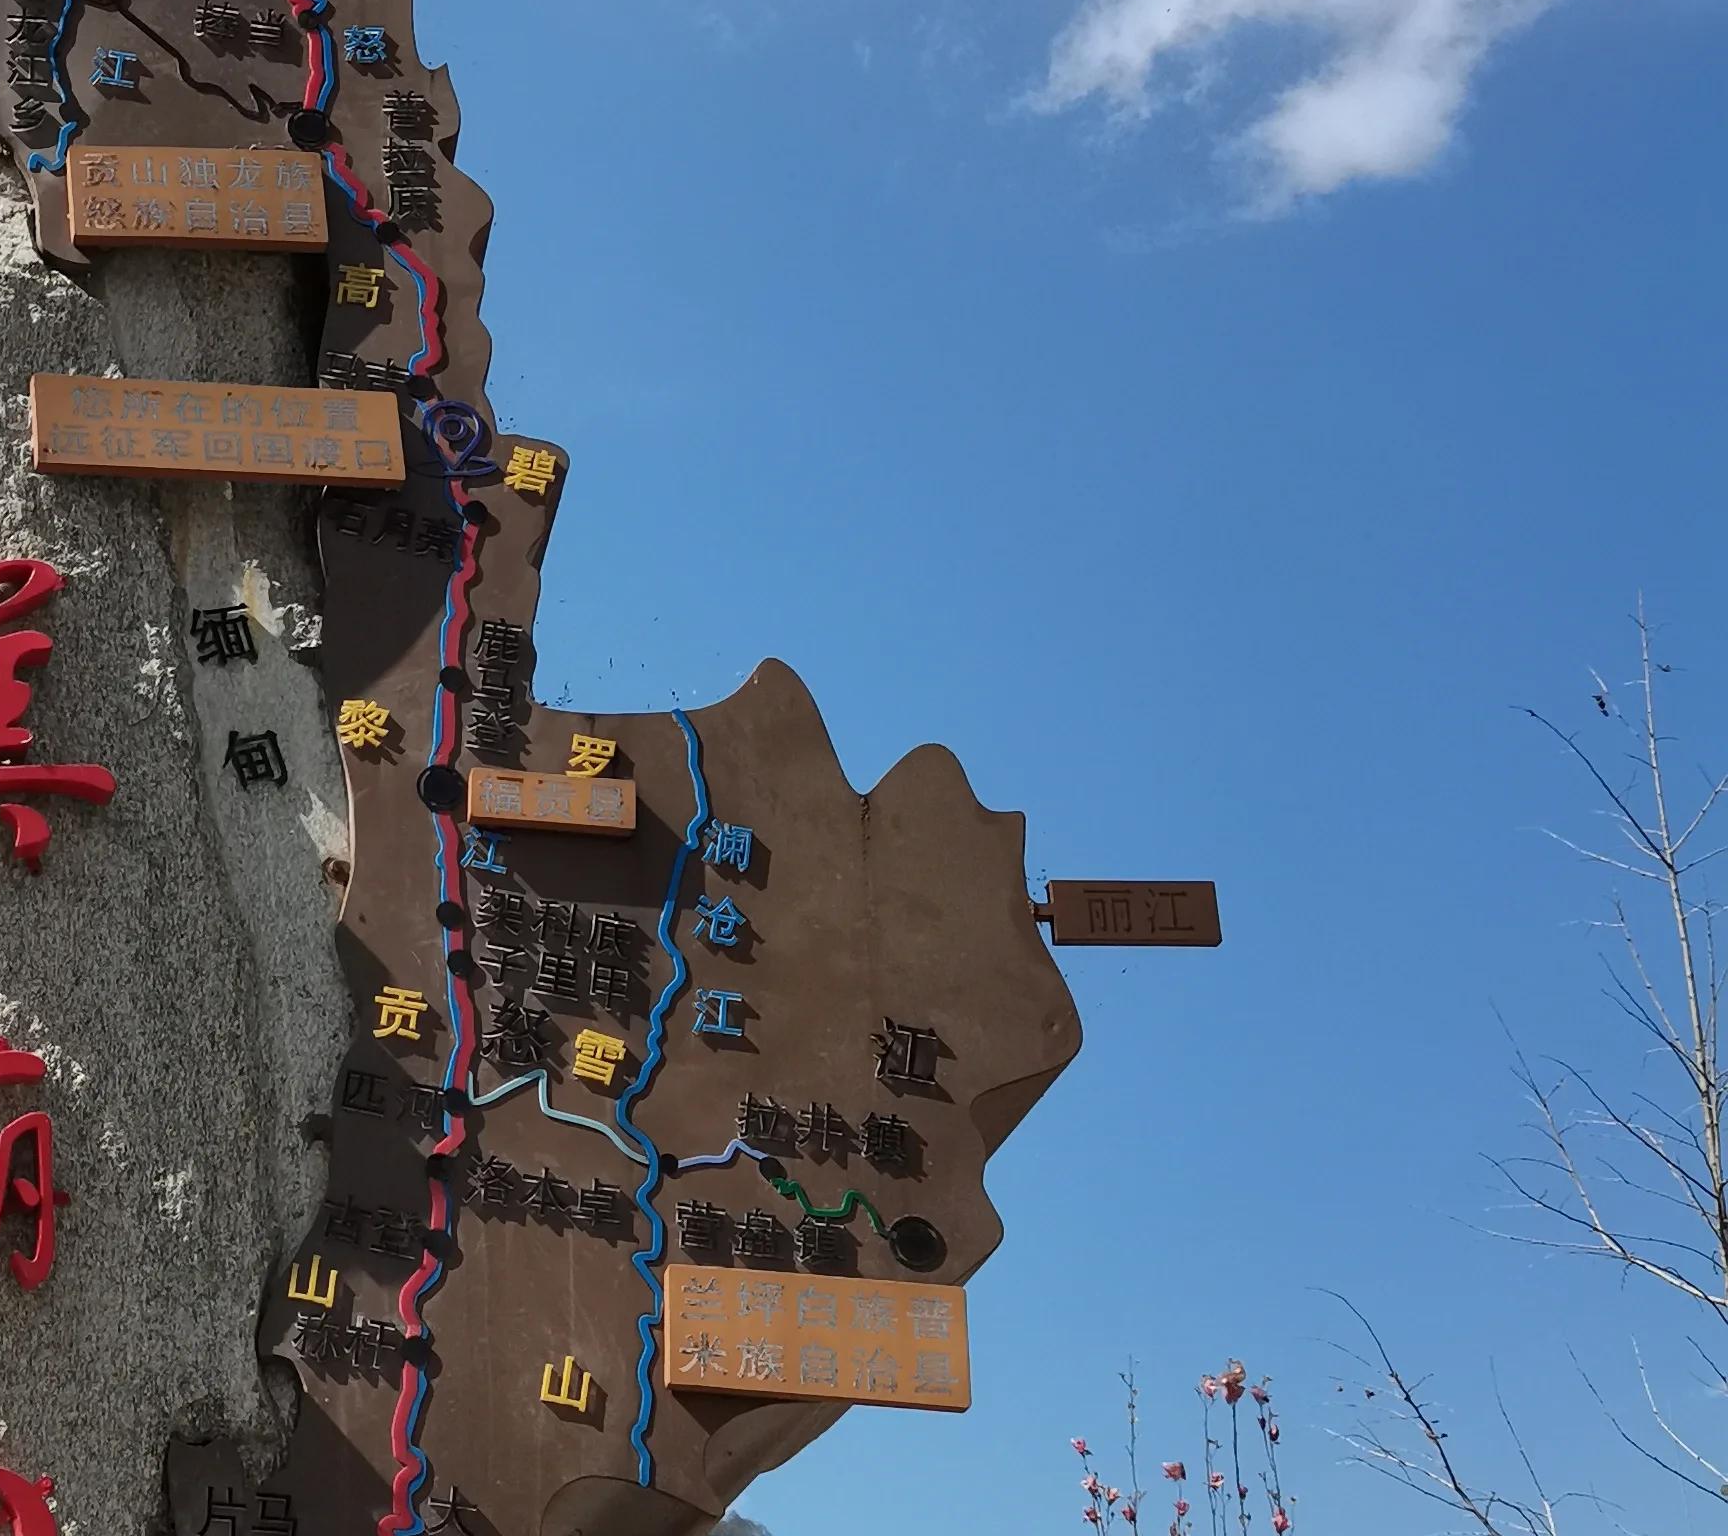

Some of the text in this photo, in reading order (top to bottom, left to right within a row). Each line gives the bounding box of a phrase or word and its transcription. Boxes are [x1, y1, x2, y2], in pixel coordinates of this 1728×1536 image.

[192, 0, 287, 46] 捧当
[89, 46, 138, 89] 江
[79, 152, 313, 194] 贡山独龙族
[381, 89, 430, 219] 普拉底
[83, 195, 315, 236] 怒族自治县
[320, 350, 411, 390] 马吉
[72, 385, 360, 432] 您所在的位置
[49, 423, 392, 471] 远征军回国渡口
[344, 25, 511, 875] 怒 江
[190, 602, 288, 792] 缅甸
[465, 618, 524, 754] 鹿马登
[288, 263, 429, 1309] 高 黎 贡 山
[479, 779, 625, 822] 福贡县
[473, 884, 638, 959] 架科底
[504, 445, 626, 1412] 碧 罗 雪 山
[692, 818, 754, 1037] 澜沧江
[1082, 889, 1195, 934] 丽江
[478, 941, 631, 1012] 子里甲
[480, 998, 938, 1085] 怒 江
[342, 1071, 446, 1131] 匹河
[735, 1091, 910, 1163] 拉井镇
[463, 1155, 622, 1227] 洛本卓
[675, 1199, 848, 1264] 营盘镇
[291, 1311, 398, 1370] 称杆
[680, 1276, 955, 1342] 兰坪白族普
[679, 1331, 959, 1396] 米族自治县
